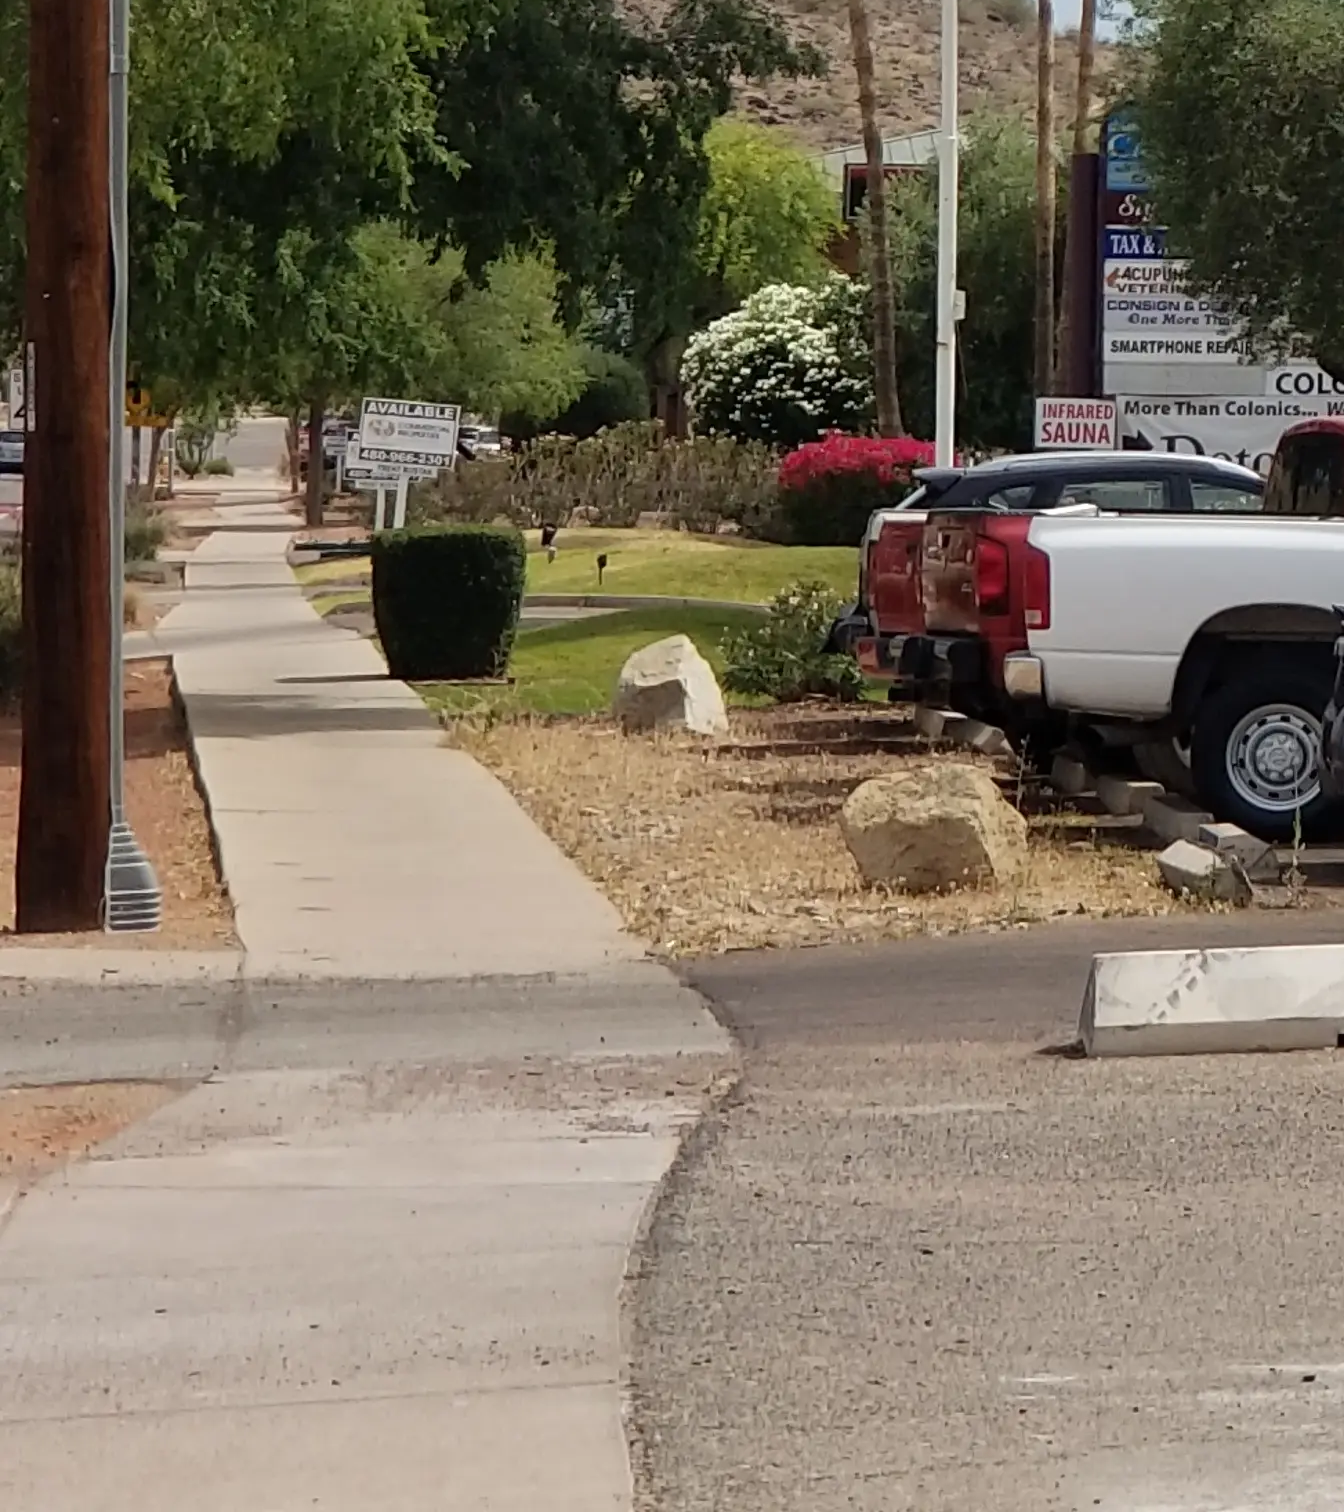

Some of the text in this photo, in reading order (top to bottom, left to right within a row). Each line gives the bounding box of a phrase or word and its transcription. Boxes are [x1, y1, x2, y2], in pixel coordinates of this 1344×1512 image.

[1110, 234, 1140, 255] TAX
[1143, 235, 1155, 255] &
[1107, 300, 1180, 311] CONSIGN
[1128, 313, 1158, 325] One
[1161, 313, 1199, 325] More
[1110, 340, 1252, 355] SMARTPHONE REPAIR
[367, 402, 455, 419] AVAILABLE
[1042, 402, 1113, 420] INFRARED
[1124, 401, 1170, 416] More
[1175, 401, 1219, 416] Than
[1225, 400, 1319, 418] Colonics...
[1041, 422, 1111, 445] SAUNA
